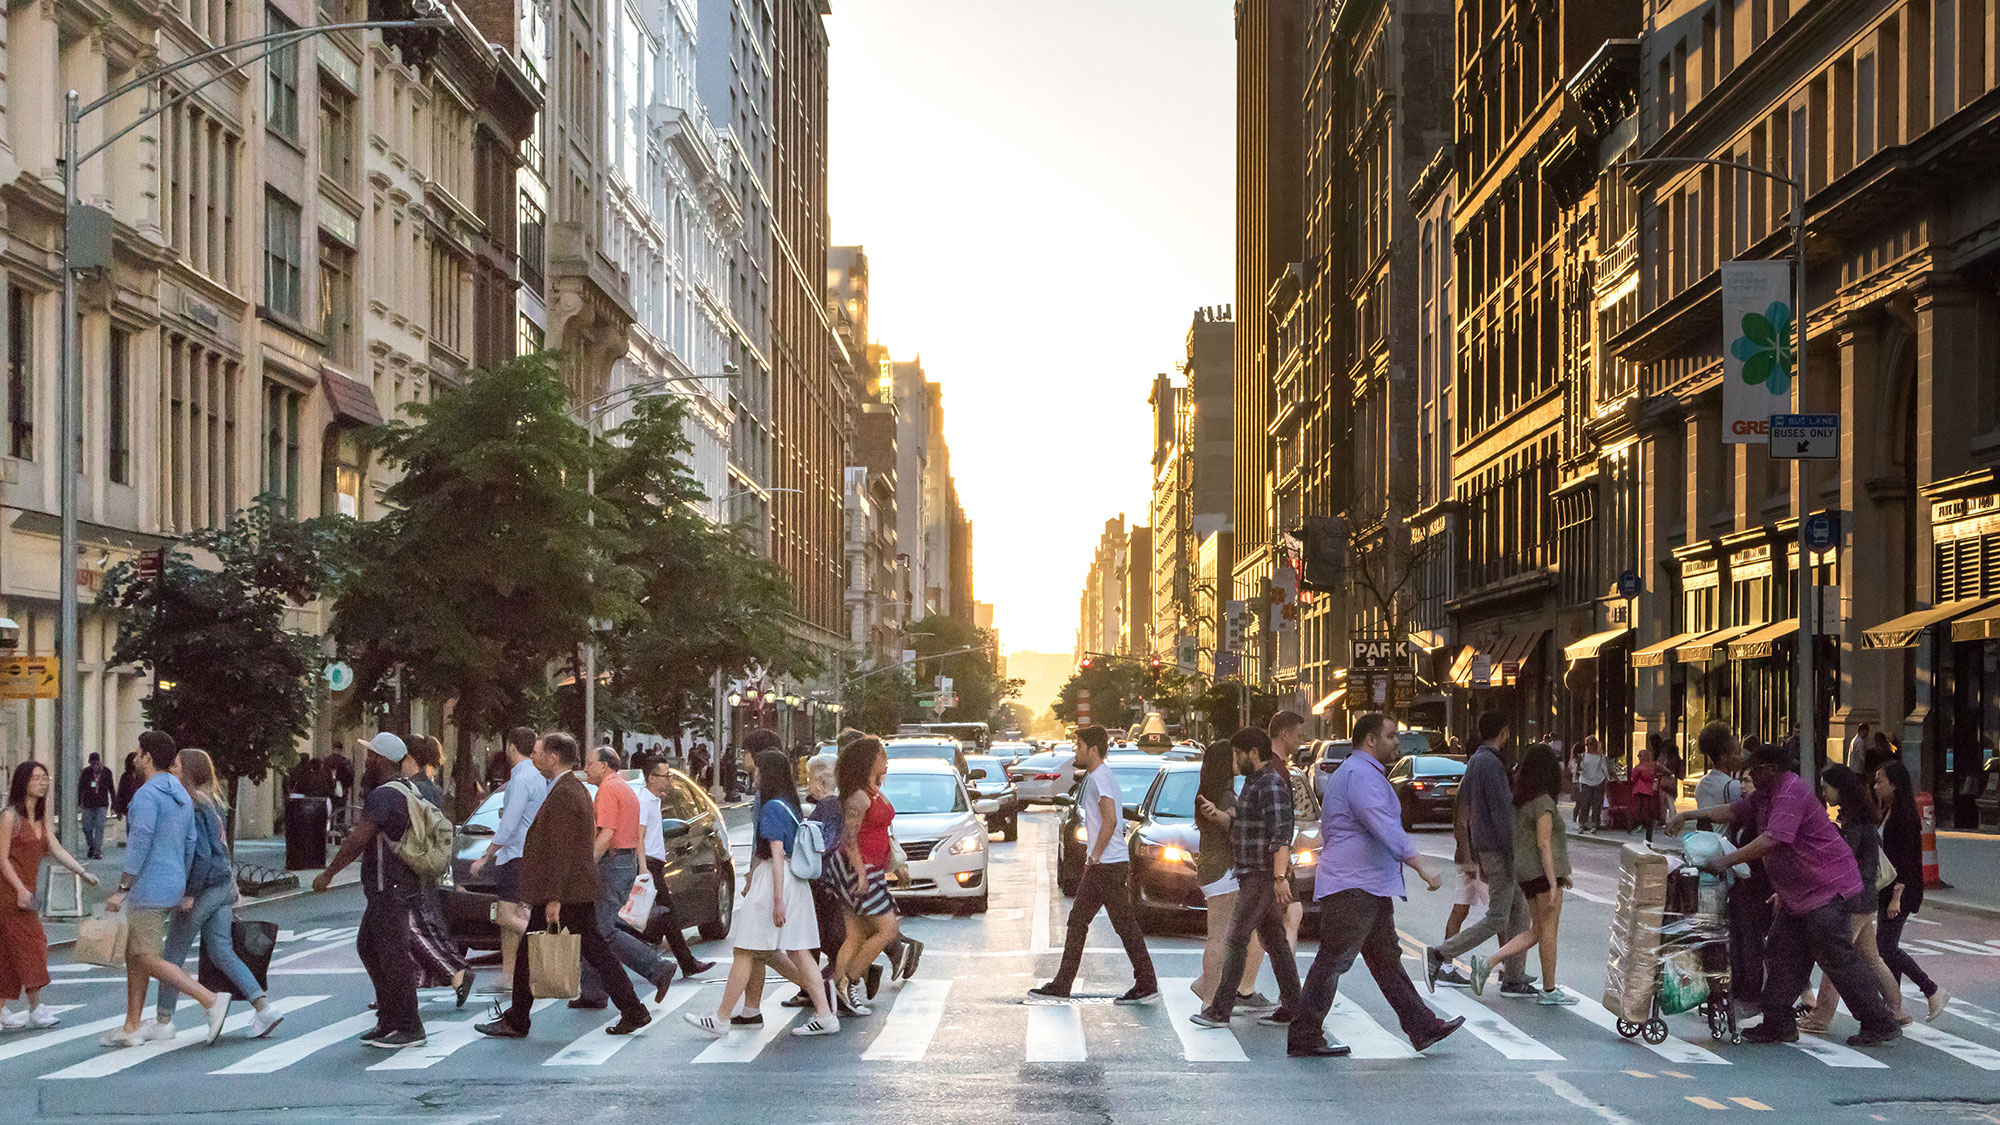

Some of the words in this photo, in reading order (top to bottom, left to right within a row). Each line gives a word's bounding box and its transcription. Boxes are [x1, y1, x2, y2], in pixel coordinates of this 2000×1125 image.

[1788, 417, 1806, 425] BUS
[1809, 417, 1834, 425] LANE
[1773, 429, 1806, 438] BUSES
[1810, 428, 1835, 438] ONLY
[1355, 641, 1408, 658] PARK
